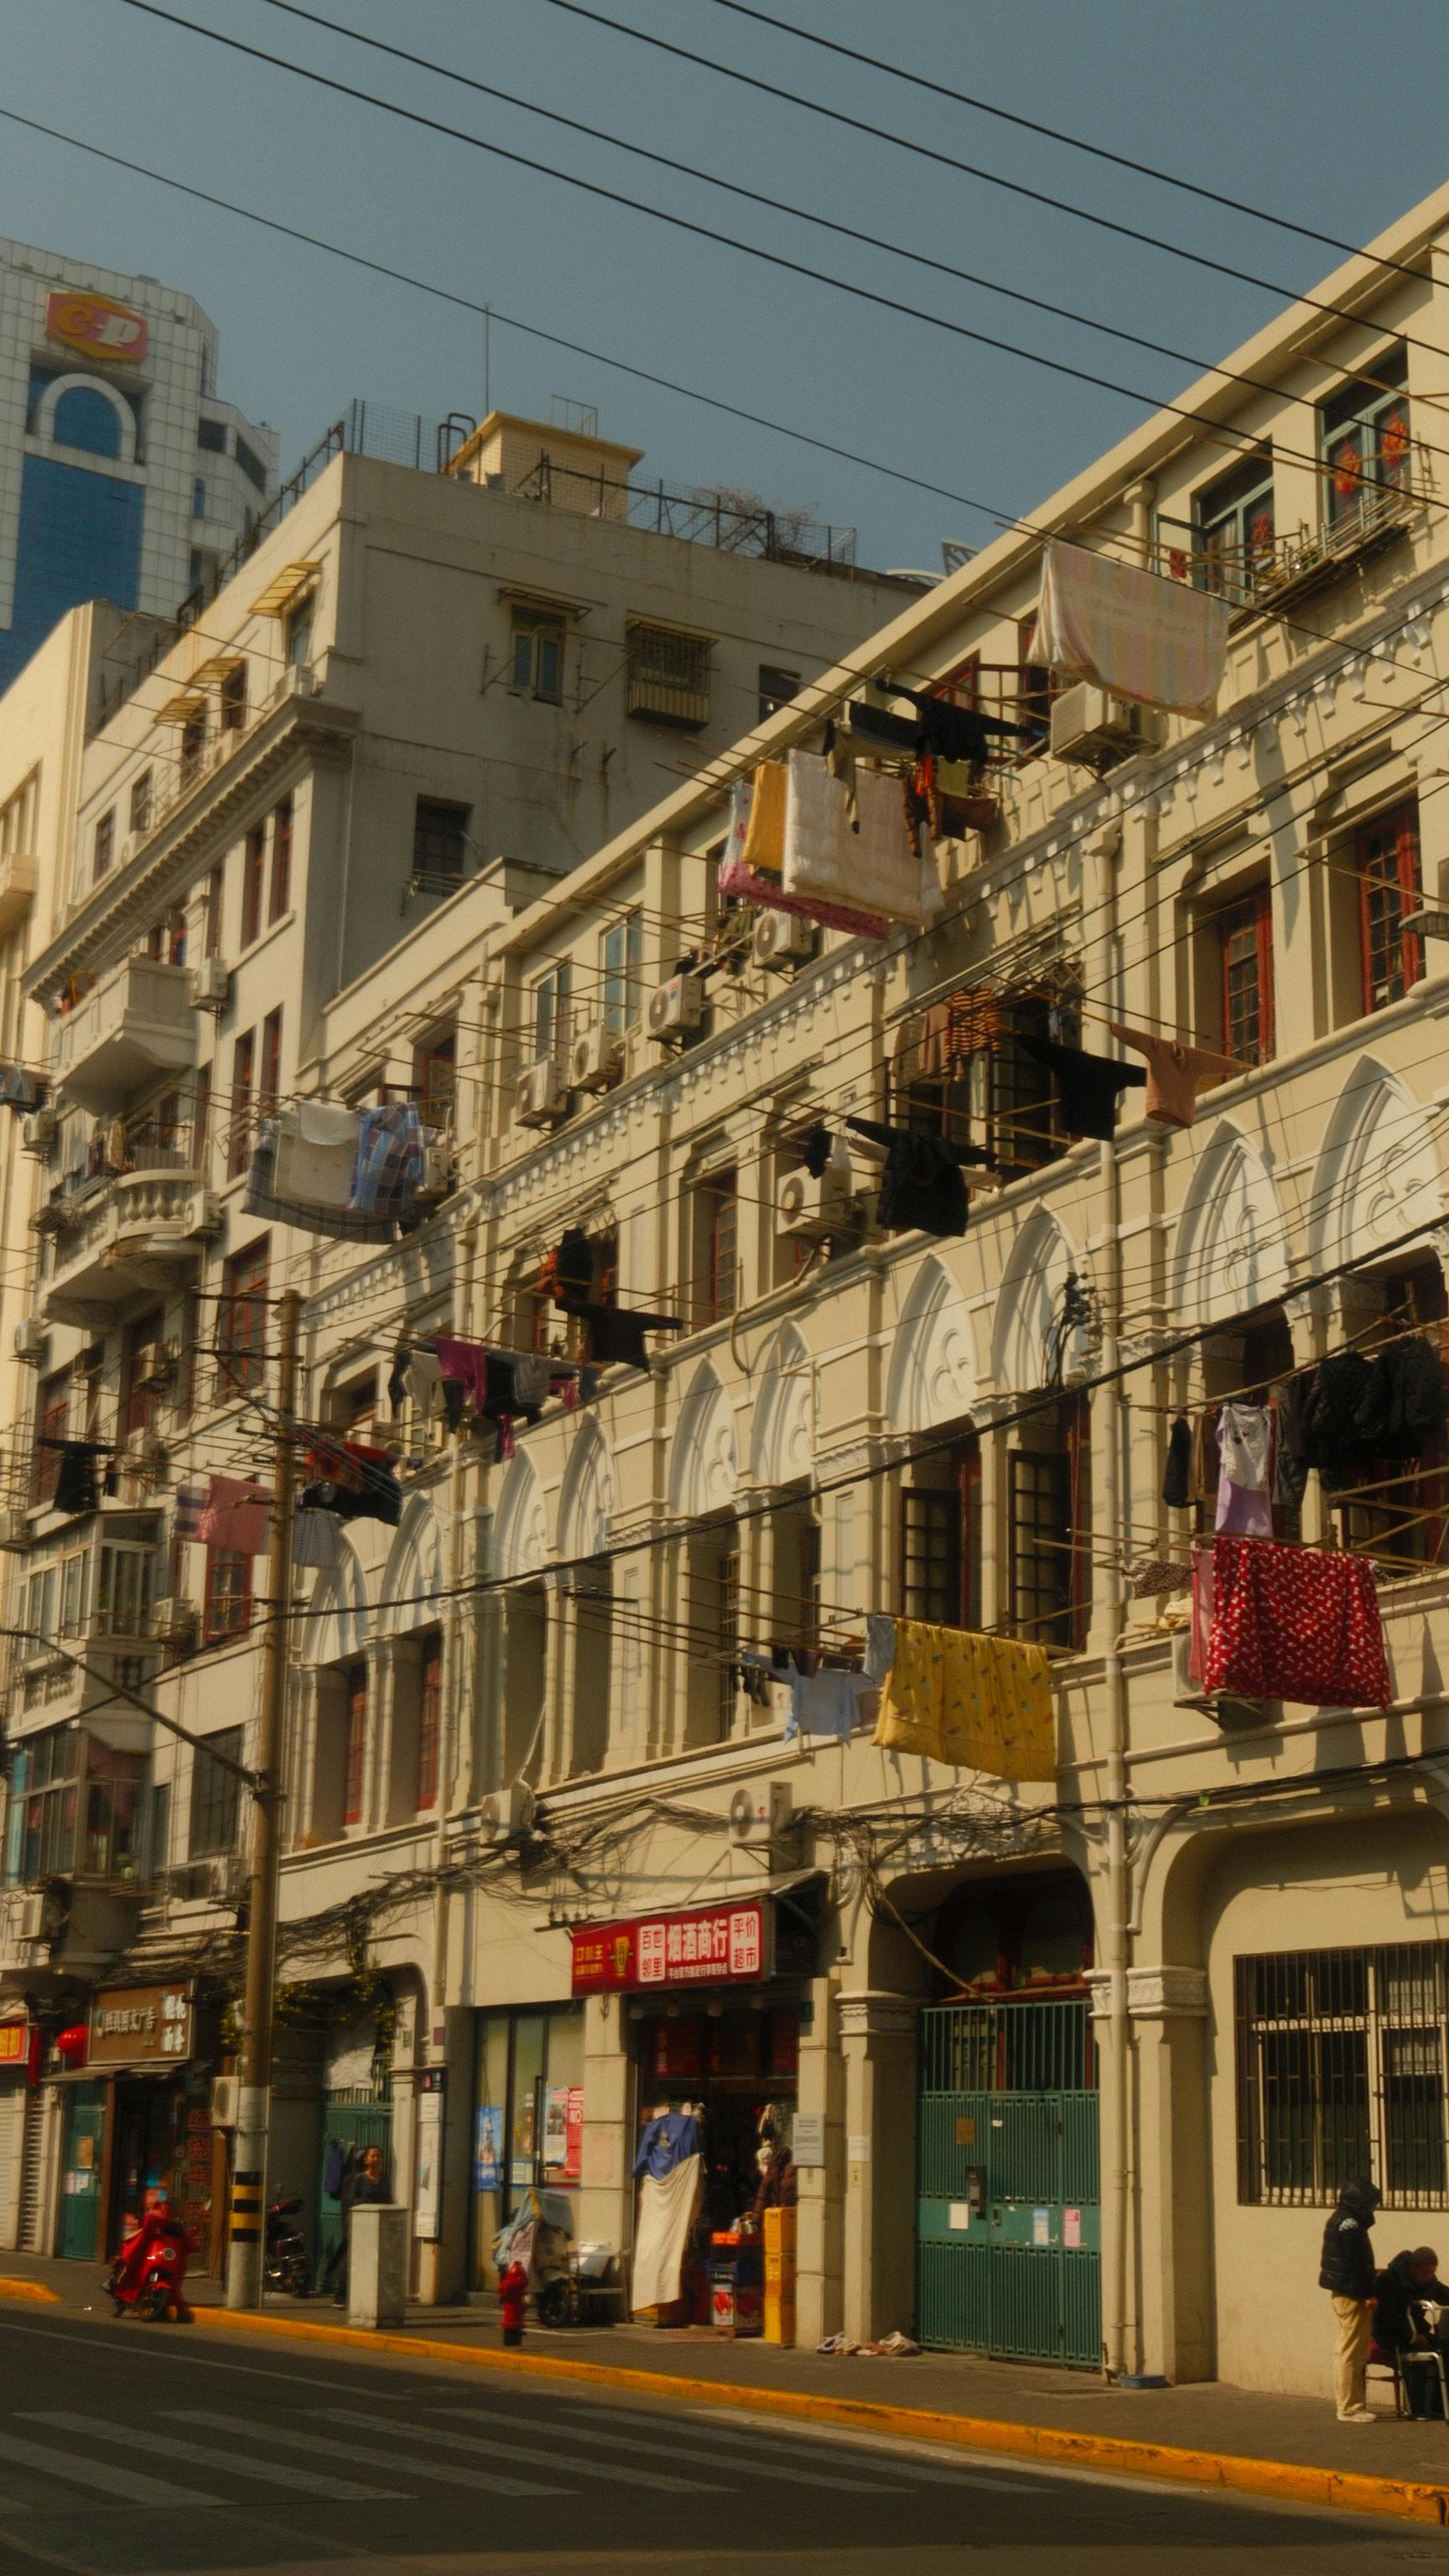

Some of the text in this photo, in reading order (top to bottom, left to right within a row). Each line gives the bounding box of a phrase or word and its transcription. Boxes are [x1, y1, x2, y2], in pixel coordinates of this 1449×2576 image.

[733, 1915, 757, 1939] 平价
[641, 1930, 662, 1950] 百世
[667, 1919, 729, 1963] 烟酒商行
[733, 1946, 757, 1970] 超市
